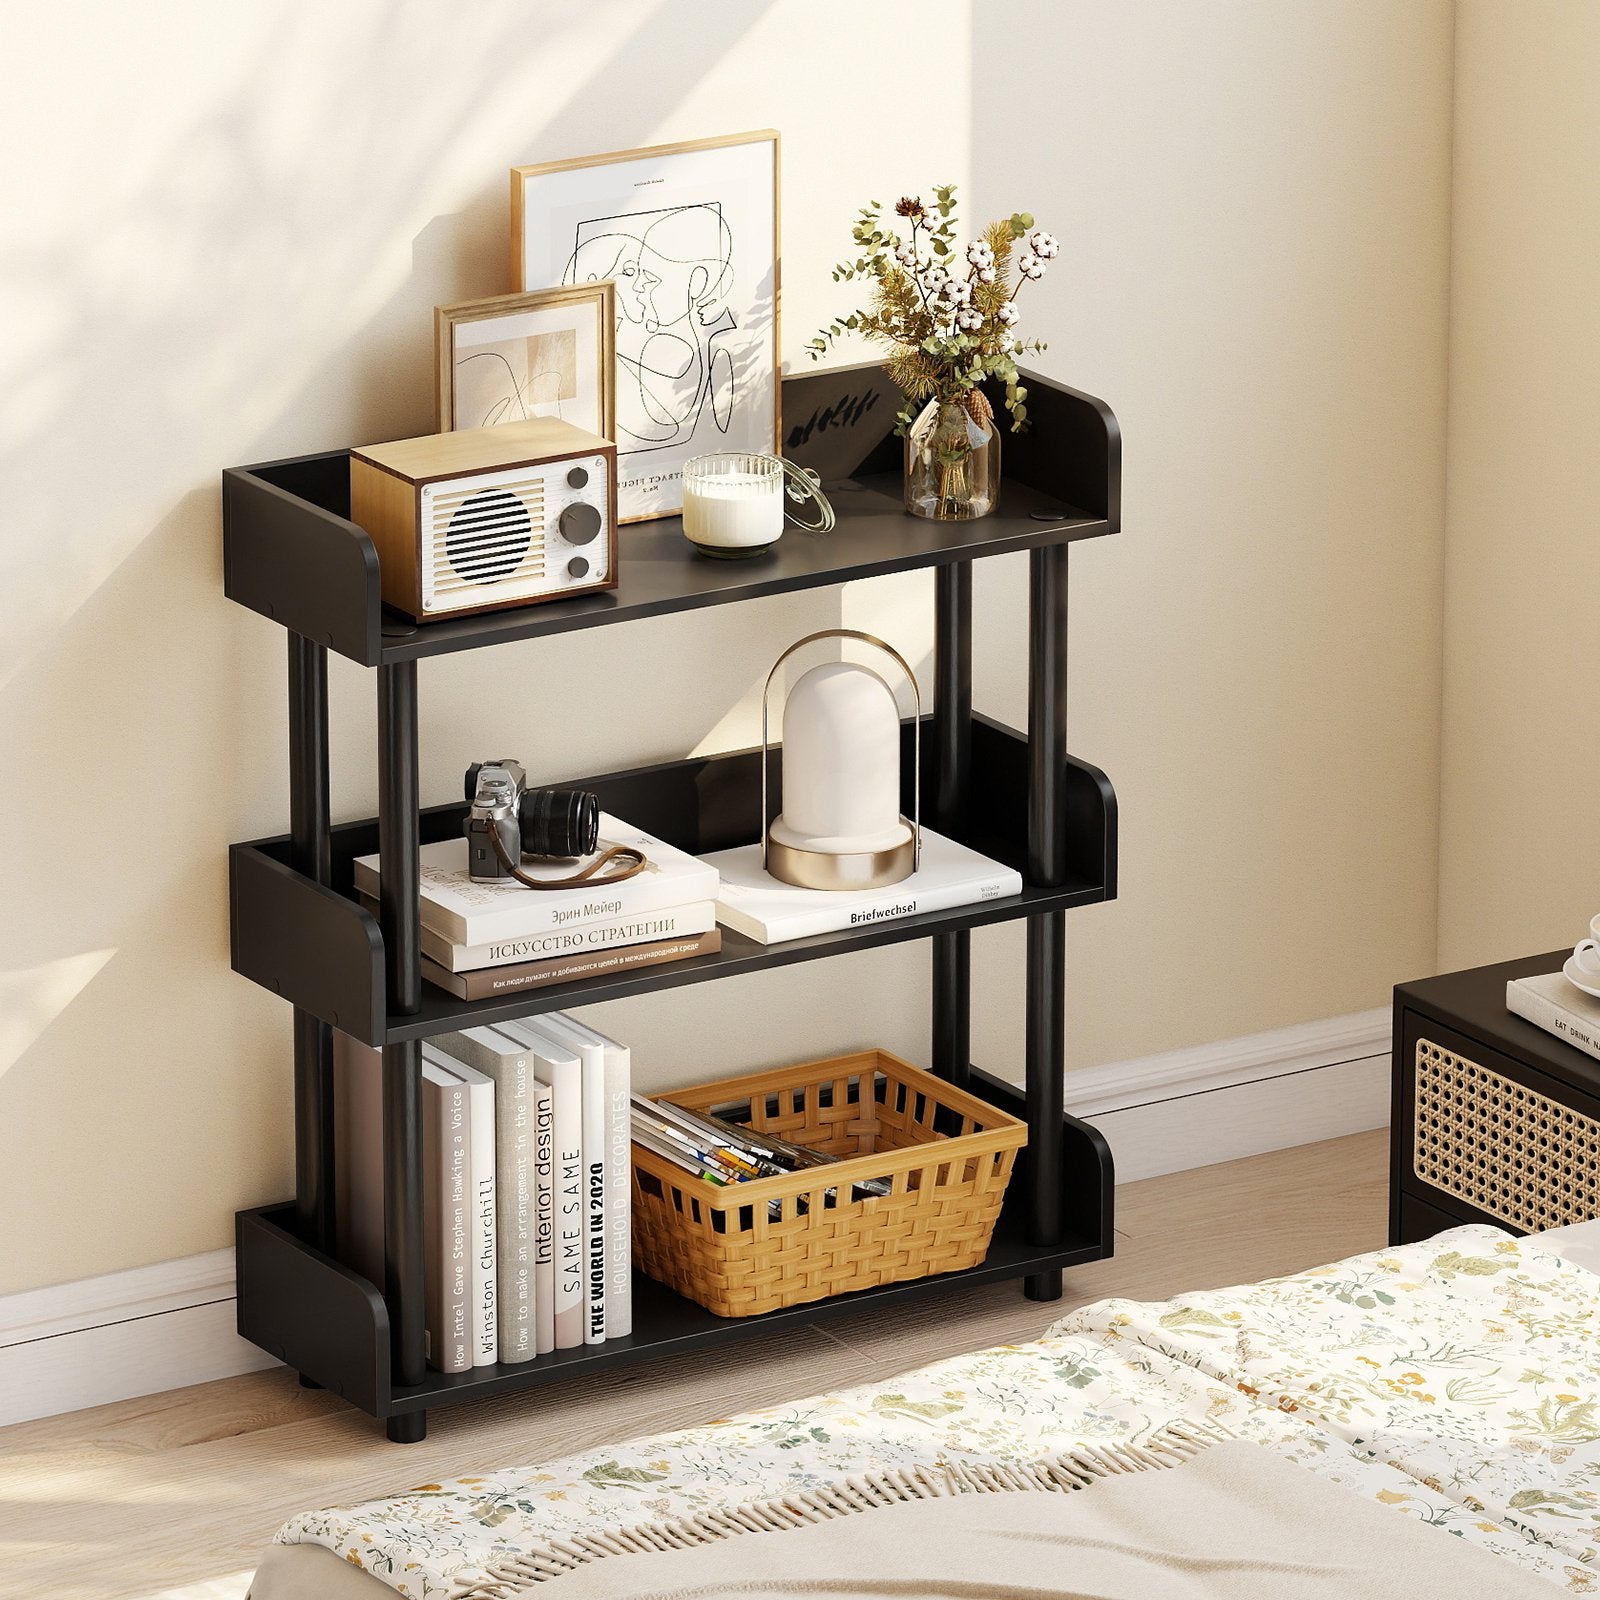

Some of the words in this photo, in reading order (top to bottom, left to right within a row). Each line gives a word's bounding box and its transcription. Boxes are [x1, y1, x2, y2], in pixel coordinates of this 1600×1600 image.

[552, 909, 581, 925] Эрин
[583, 900, 622, 916] Мейер
[850, 901, 917, 924] Briefwechsel
[489, 933, 584, 960] ИСКУССТВО
[588, 918, 675, 944] СТРАТЕГИИ
[493, 979, 506, 989] Как
[506, 977, 525, 987] люди
[524, 972, 551, 984] думают
[557, 962, 598, 977] добиваются
[598, 957, 619, 969] целей
[619, 957, 624, 965] в
[624, 945, 679, 964] международной
[679, 942, 699, 953] среде
[1555, 1019, 1567, 1031] EAT
[1570, 1027, 1590, 1045] DRINK
[1593, 1041, 1600, 1050] N
[514, 1059, 526, 1099] house
[451, 1092, 462, 1129] Voice
[515, 1105, 526, 1127] the
[514, 1134, 526, 1151] in
[534, 1098, 553, 1175] design
[612, 1090, 627, 1188] DECORATES
[452, 1149, 465, 1202] Hawking
[562, 1149, 580, 1214] SAME
[590, 1162, 603, 1210] 2020
[517, 1157, 529, 1239] arrangement
[452, 1207, 465, 1259] Stephen
[480, 1176, 493, 1269] Churchill
[534, 1184, 552, 1264] Interior
[590, 1213, 604, 1233] IN
[519, 1246, 527, 1261] an
[563, 1227, 581, 1293] SAME
[613, 1198, 627, 1295] HOUSEHOLD
[453, 1265, 464, 1295] Gave
[516, 1269, 528, 1299] make
[590, 1236, 604, 1301] WORLD
[452, 1301, 464, 1338] Intel
[481, 1280, 494, 1354] Winston
[518, 1305, 528, 1321] to
[591, 1303, 604, 1337] THE
[453, 1344, 464, 1367] How
[517, 1328, 528, 1351] How
